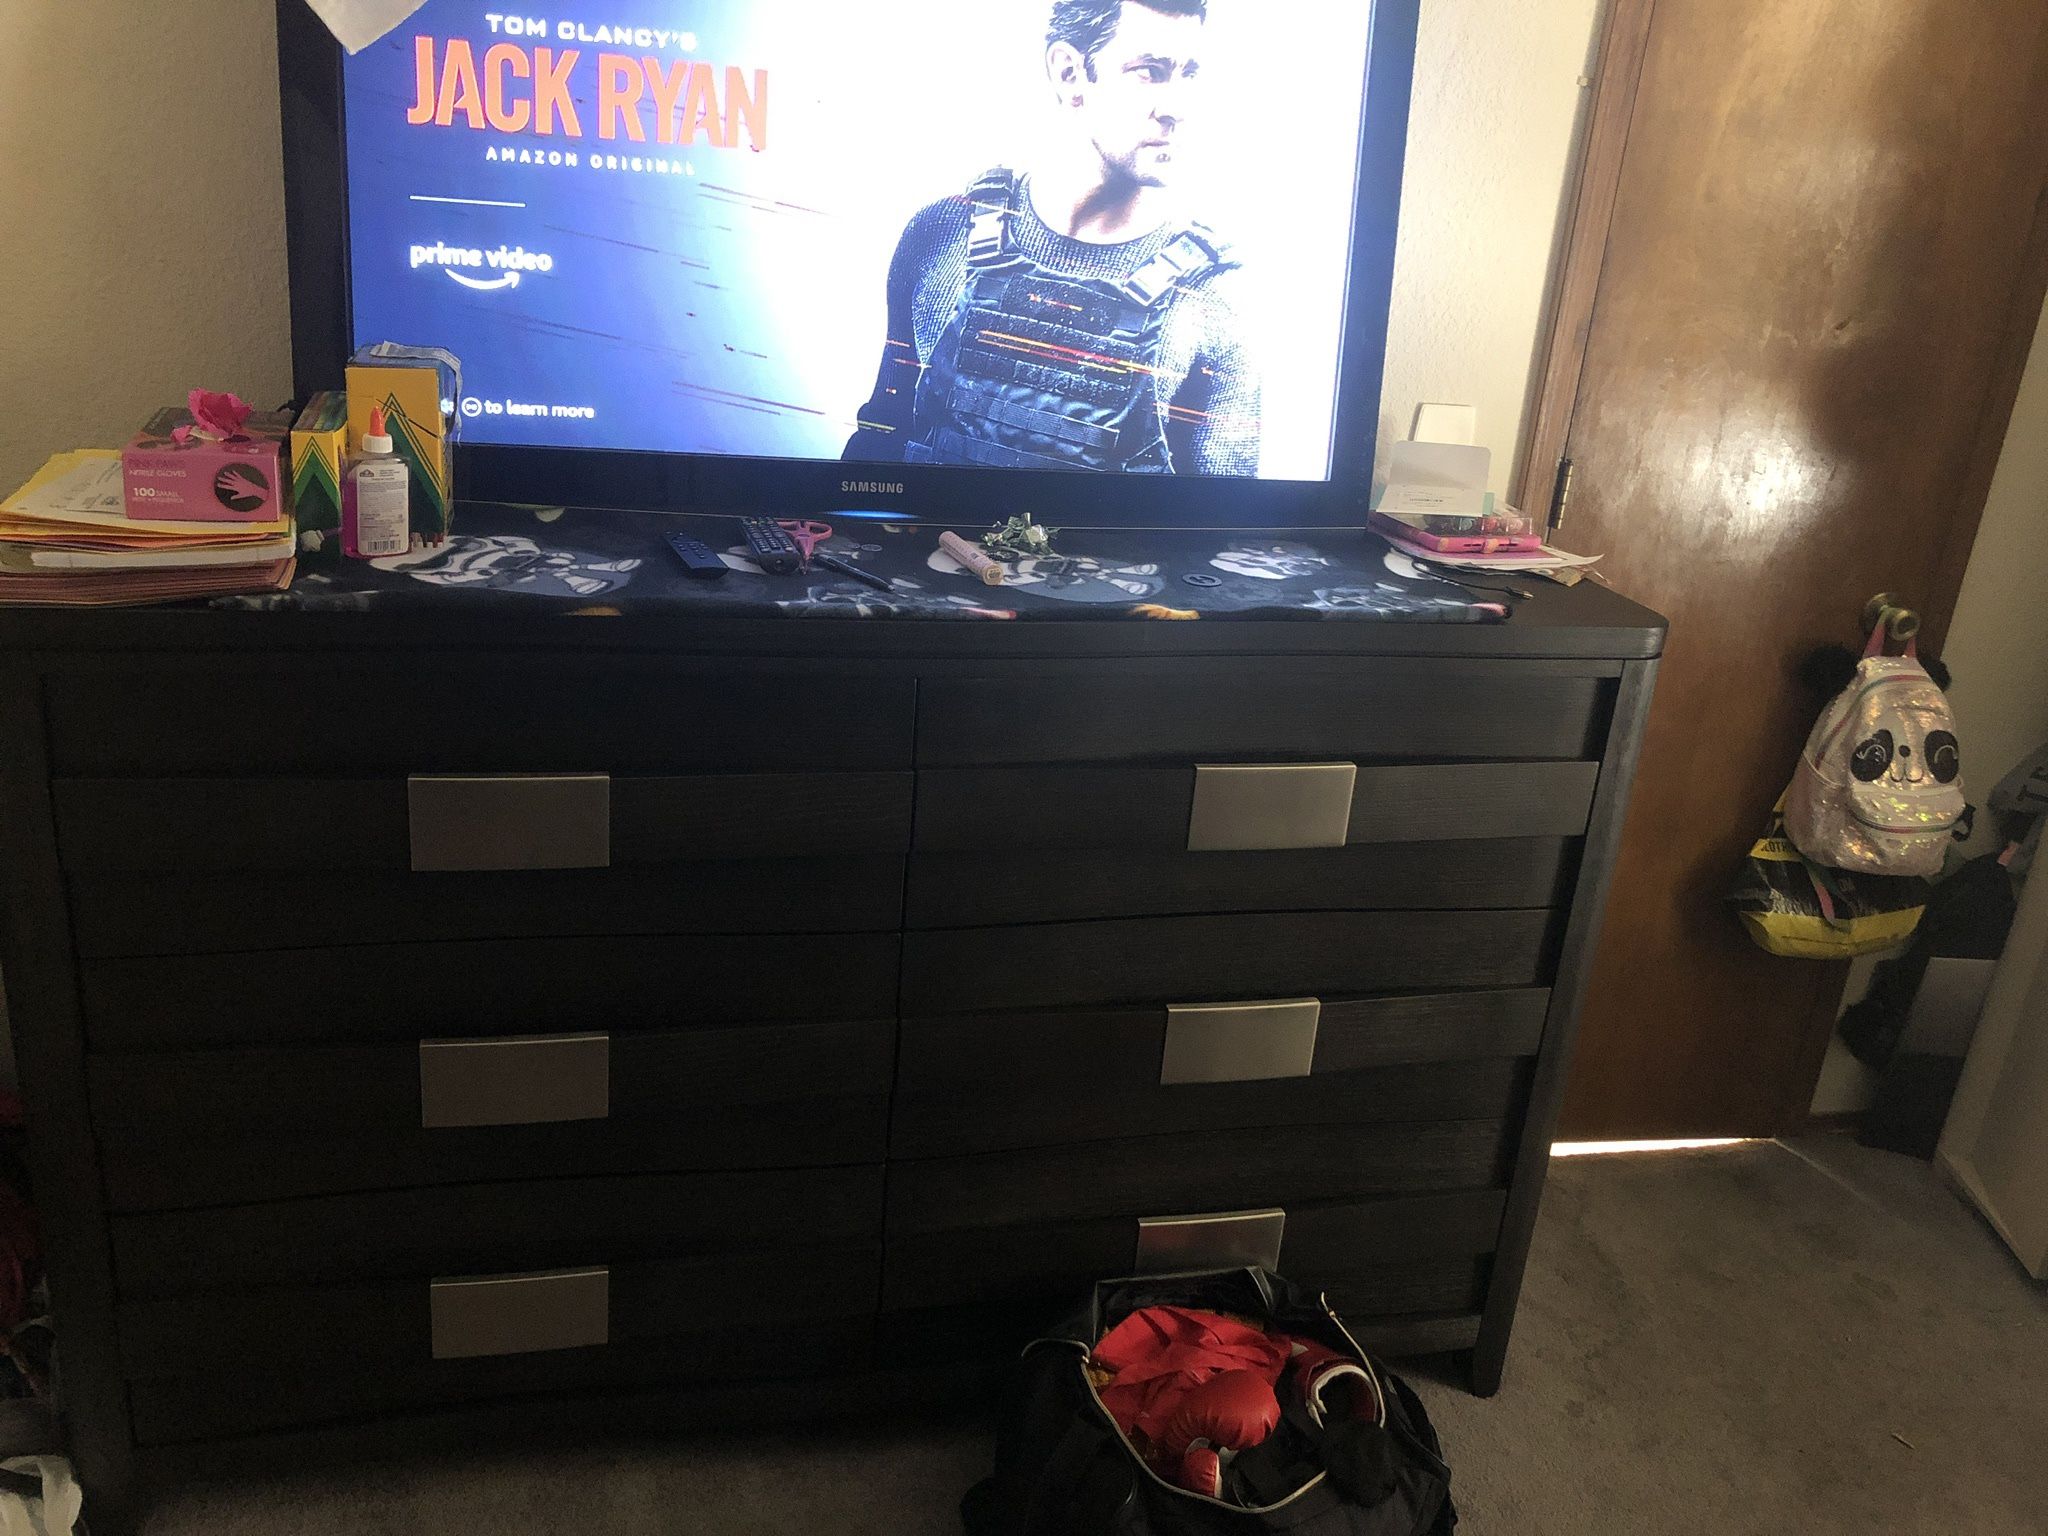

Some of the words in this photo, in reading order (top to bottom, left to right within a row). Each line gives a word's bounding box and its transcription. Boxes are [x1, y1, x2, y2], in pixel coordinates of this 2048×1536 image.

[485, 13, 547, 38] TOM
[557, 20, 698, 51] CLANCY'S
[407, 35, 582, 137] JACK
[598, 53, 768, 152] RYAN
[485, 146, 578, 168] AMAZON
[590, 154, 696, 177] ORIGINAL
[410, 241, 482, 268] prime
[485, 245, 552, 271] video
[484, 399, 503, 415] to
[506, 399, 548, 417] learn
[551, 404, 595, 419] more
[156, 469, 186, 478] GLOVES
[133, 487, 155, 497] 100
[841, 480, 904, 494] SAMSUNG
